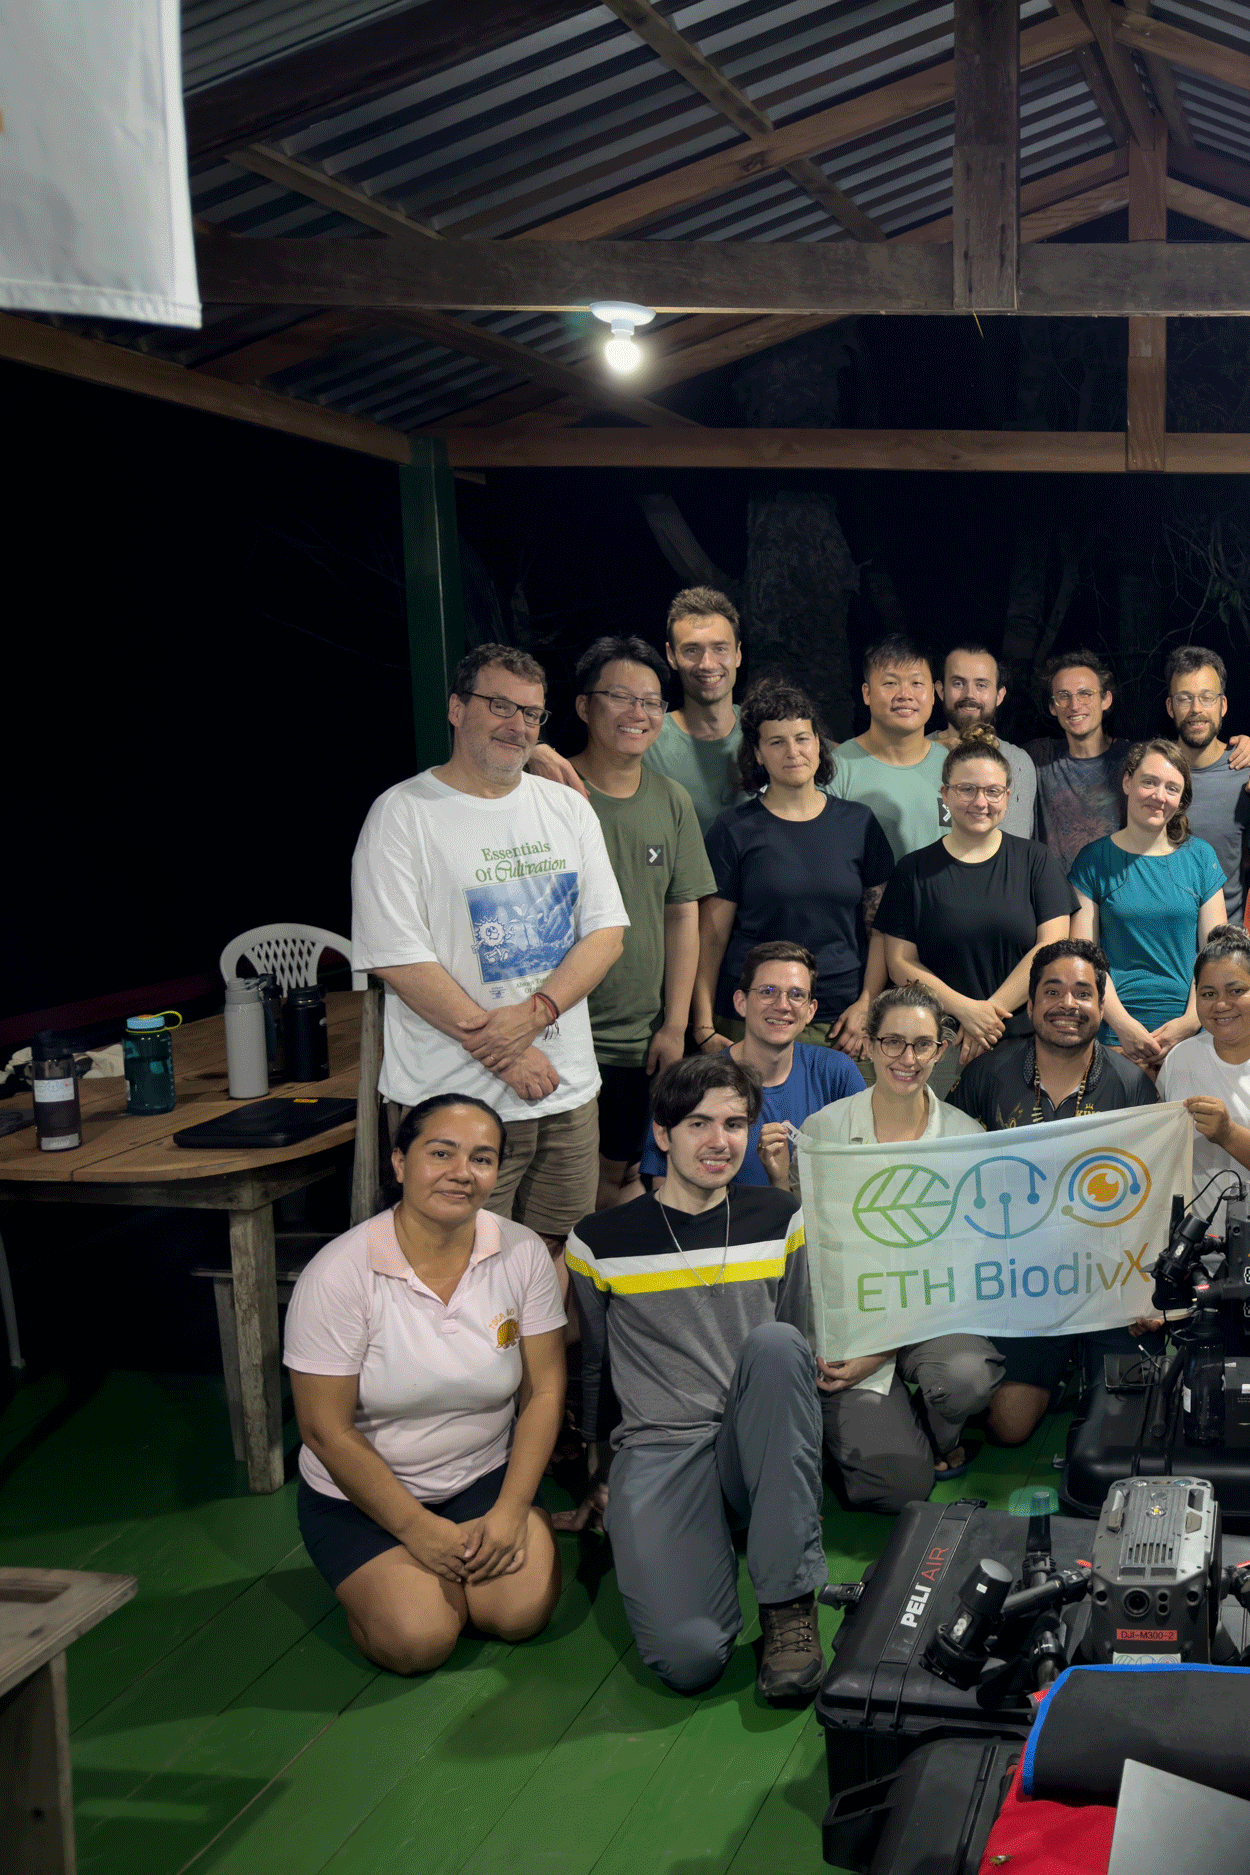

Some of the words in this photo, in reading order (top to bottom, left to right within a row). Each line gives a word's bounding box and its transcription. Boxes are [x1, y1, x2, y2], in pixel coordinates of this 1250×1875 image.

[481, 840, 551, 862] Essentials
[475, 867, 493, 883] Of
[494, 857, 567, 883] Cultivation
[857, 1265, 956, 1313] ETH
[974, 1241, 1151, 1302] BiodivX
[900, 1583, 932, 1629] PELI
[921, 1547, 950, 1582] AIR
[1120, 1629, 1175, 1641] DJI-M300-2
